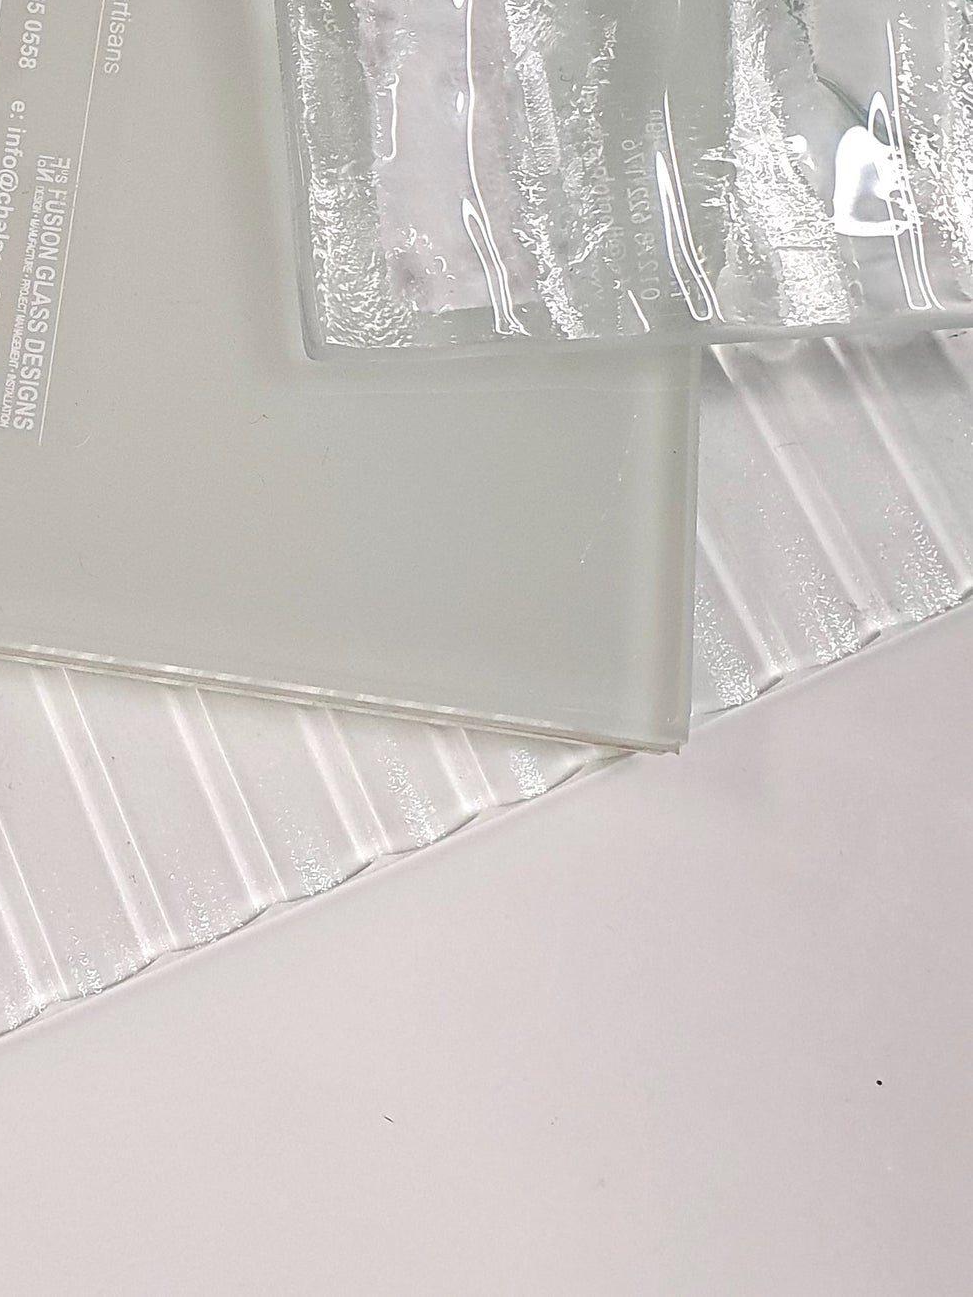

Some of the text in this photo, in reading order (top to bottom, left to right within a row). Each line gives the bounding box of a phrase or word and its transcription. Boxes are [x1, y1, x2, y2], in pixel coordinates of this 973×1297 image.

[18, 20, 43, 70] 0558
[13, 189, 68, 431] FUSION GLASS DESIGNS
